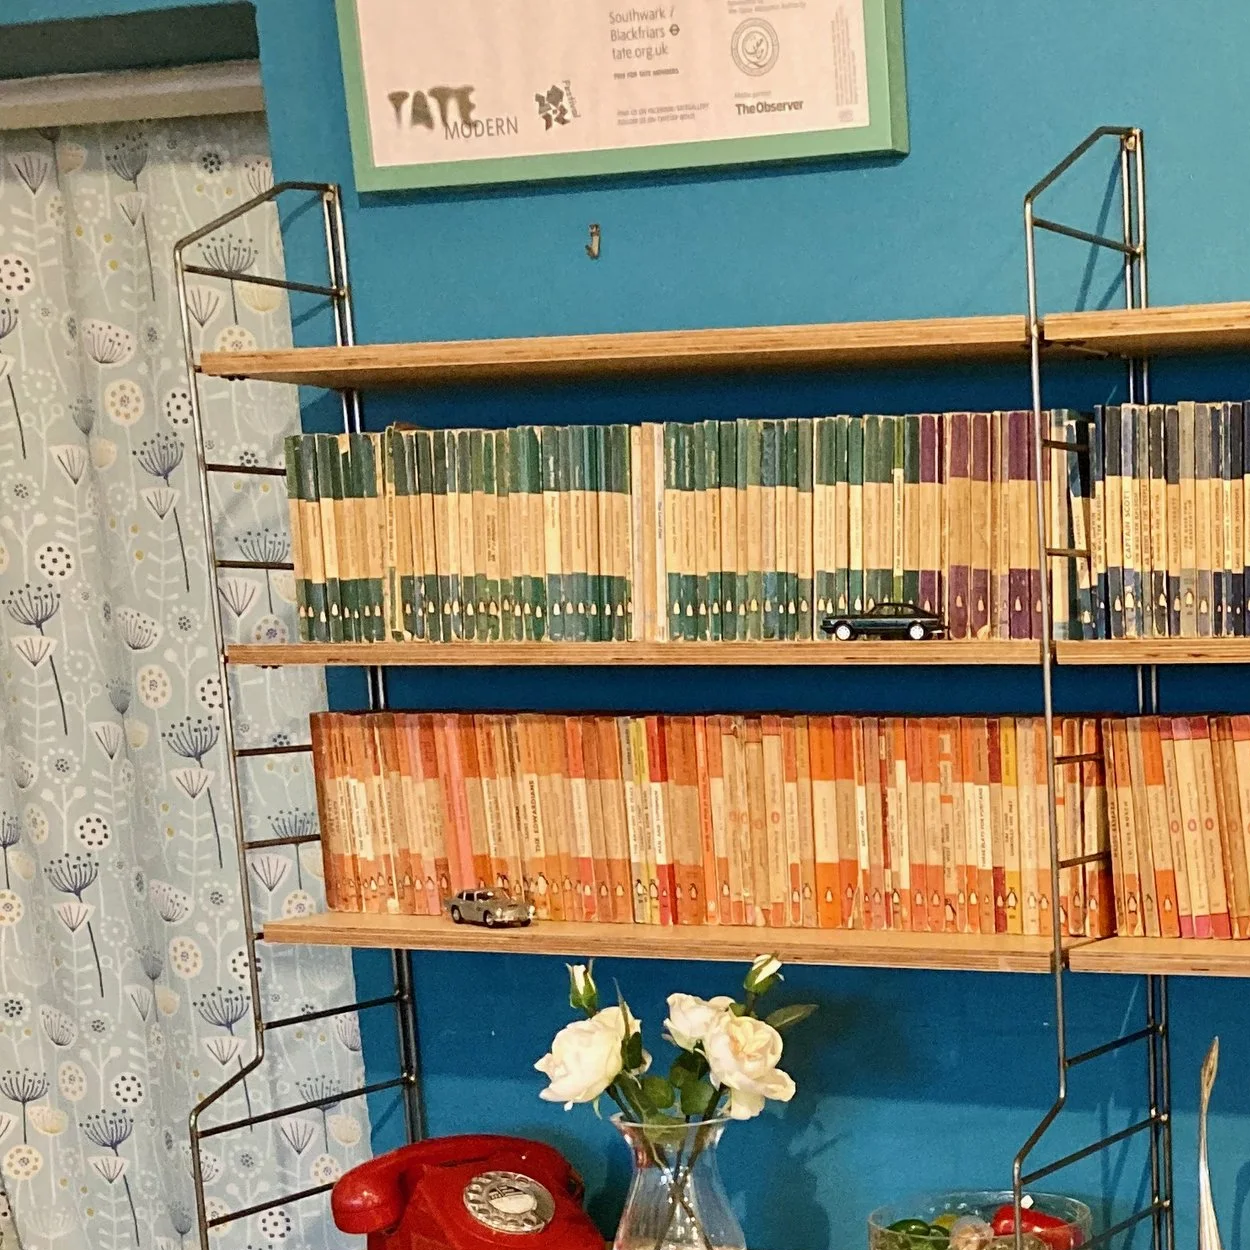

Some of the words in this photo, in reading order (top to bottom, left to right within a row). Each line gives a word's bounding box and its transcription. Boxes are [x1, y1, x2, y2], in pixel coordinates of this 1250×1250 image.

[609, 9, 666, 24] Southwark
[610, 24, 665, 41] Blackfriars
[612, 43, 668, 60] tate.org.uk
[388, 85, 476, 131] TATE
[445, 116, 519, 140] MODERN
[529, 780, 539, 834] EDWARDIANS
[1123, 801, 1131, 828] NORTH
